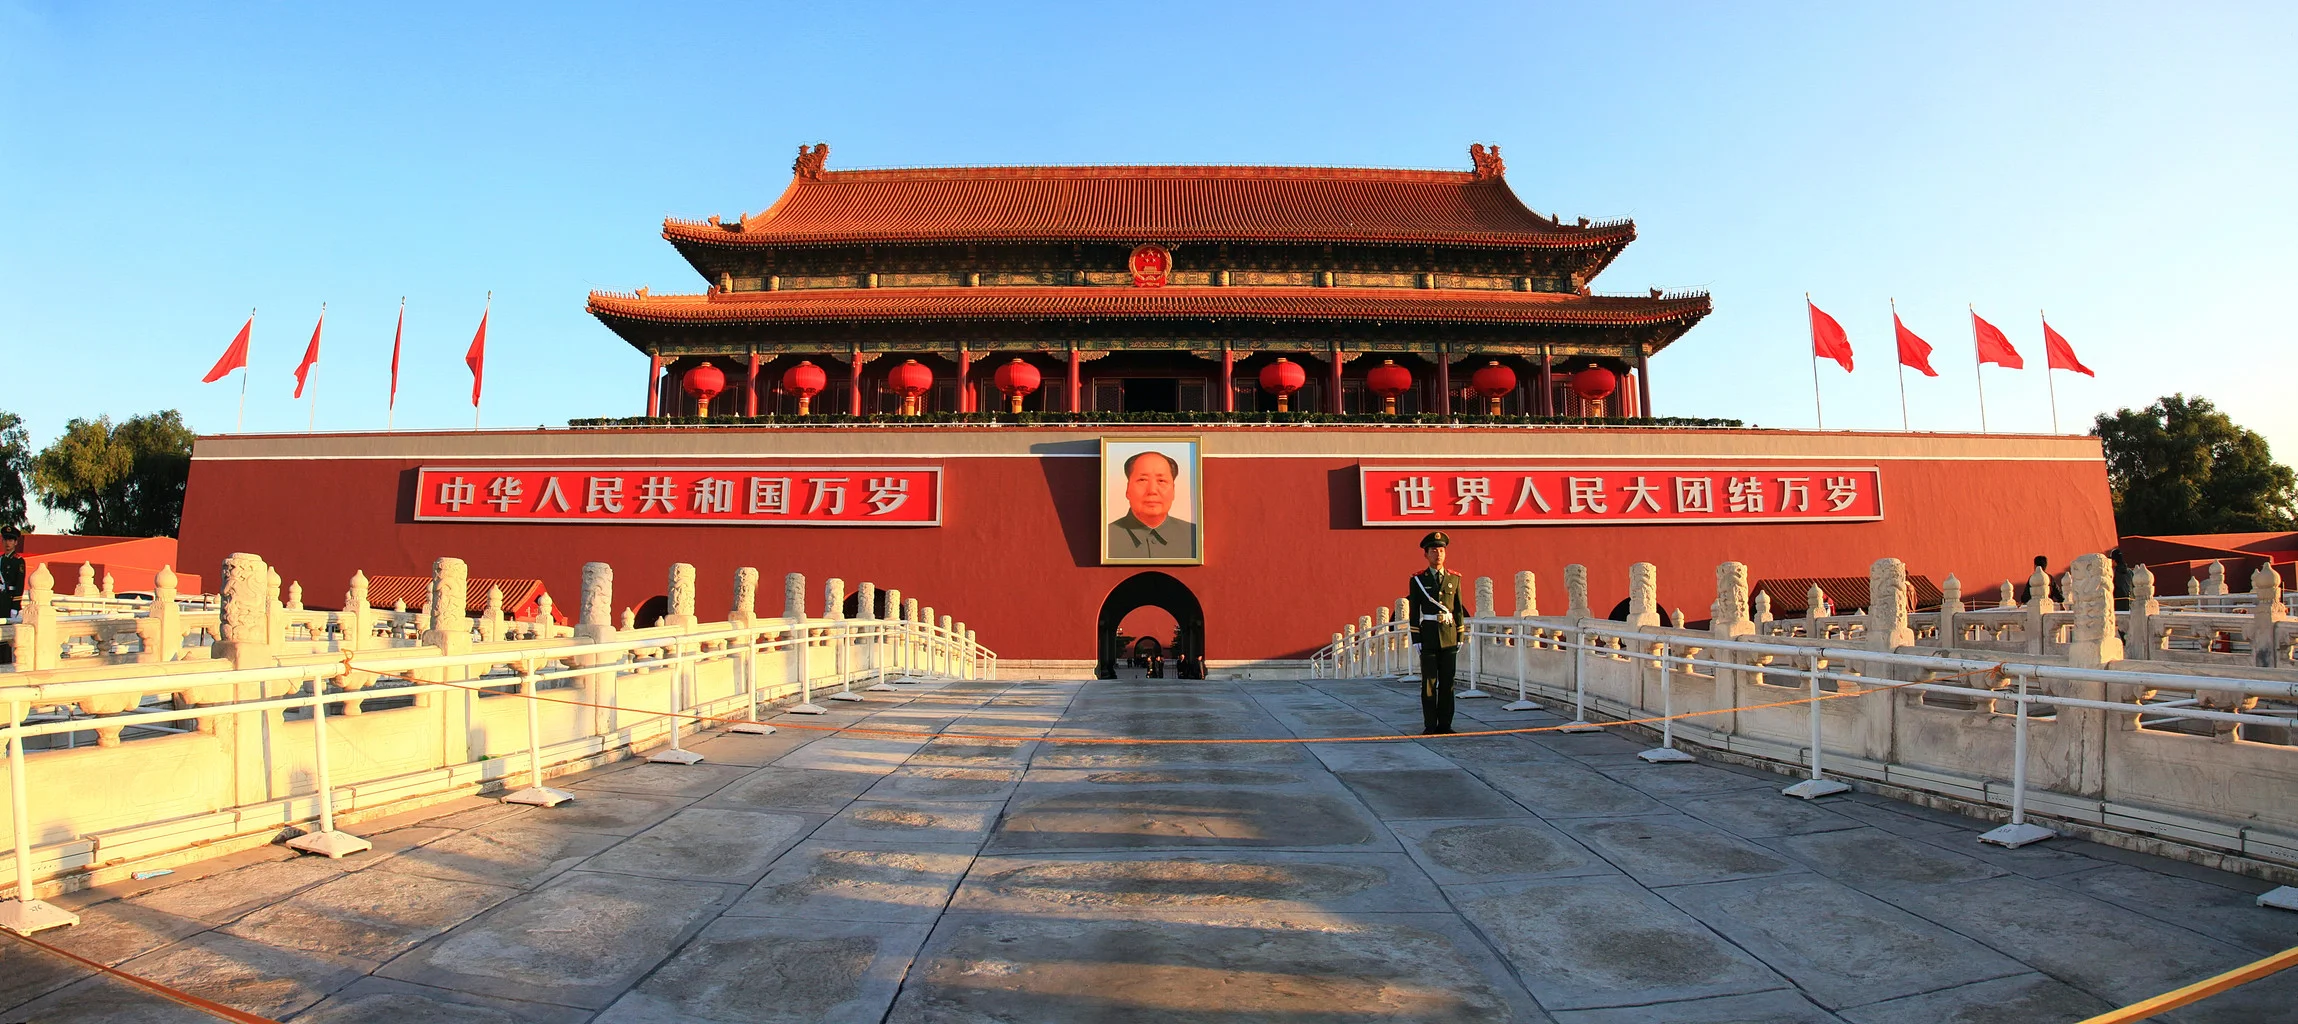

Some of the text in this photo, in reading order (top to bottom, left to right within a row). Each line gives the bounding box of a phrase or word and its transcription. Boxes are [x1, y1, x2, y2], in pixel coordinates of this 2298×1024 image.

[440, 476, 909, 516] 中华人民共和国万岁
[1394, 476, 1859, 516] 世界人民大团结万岁
